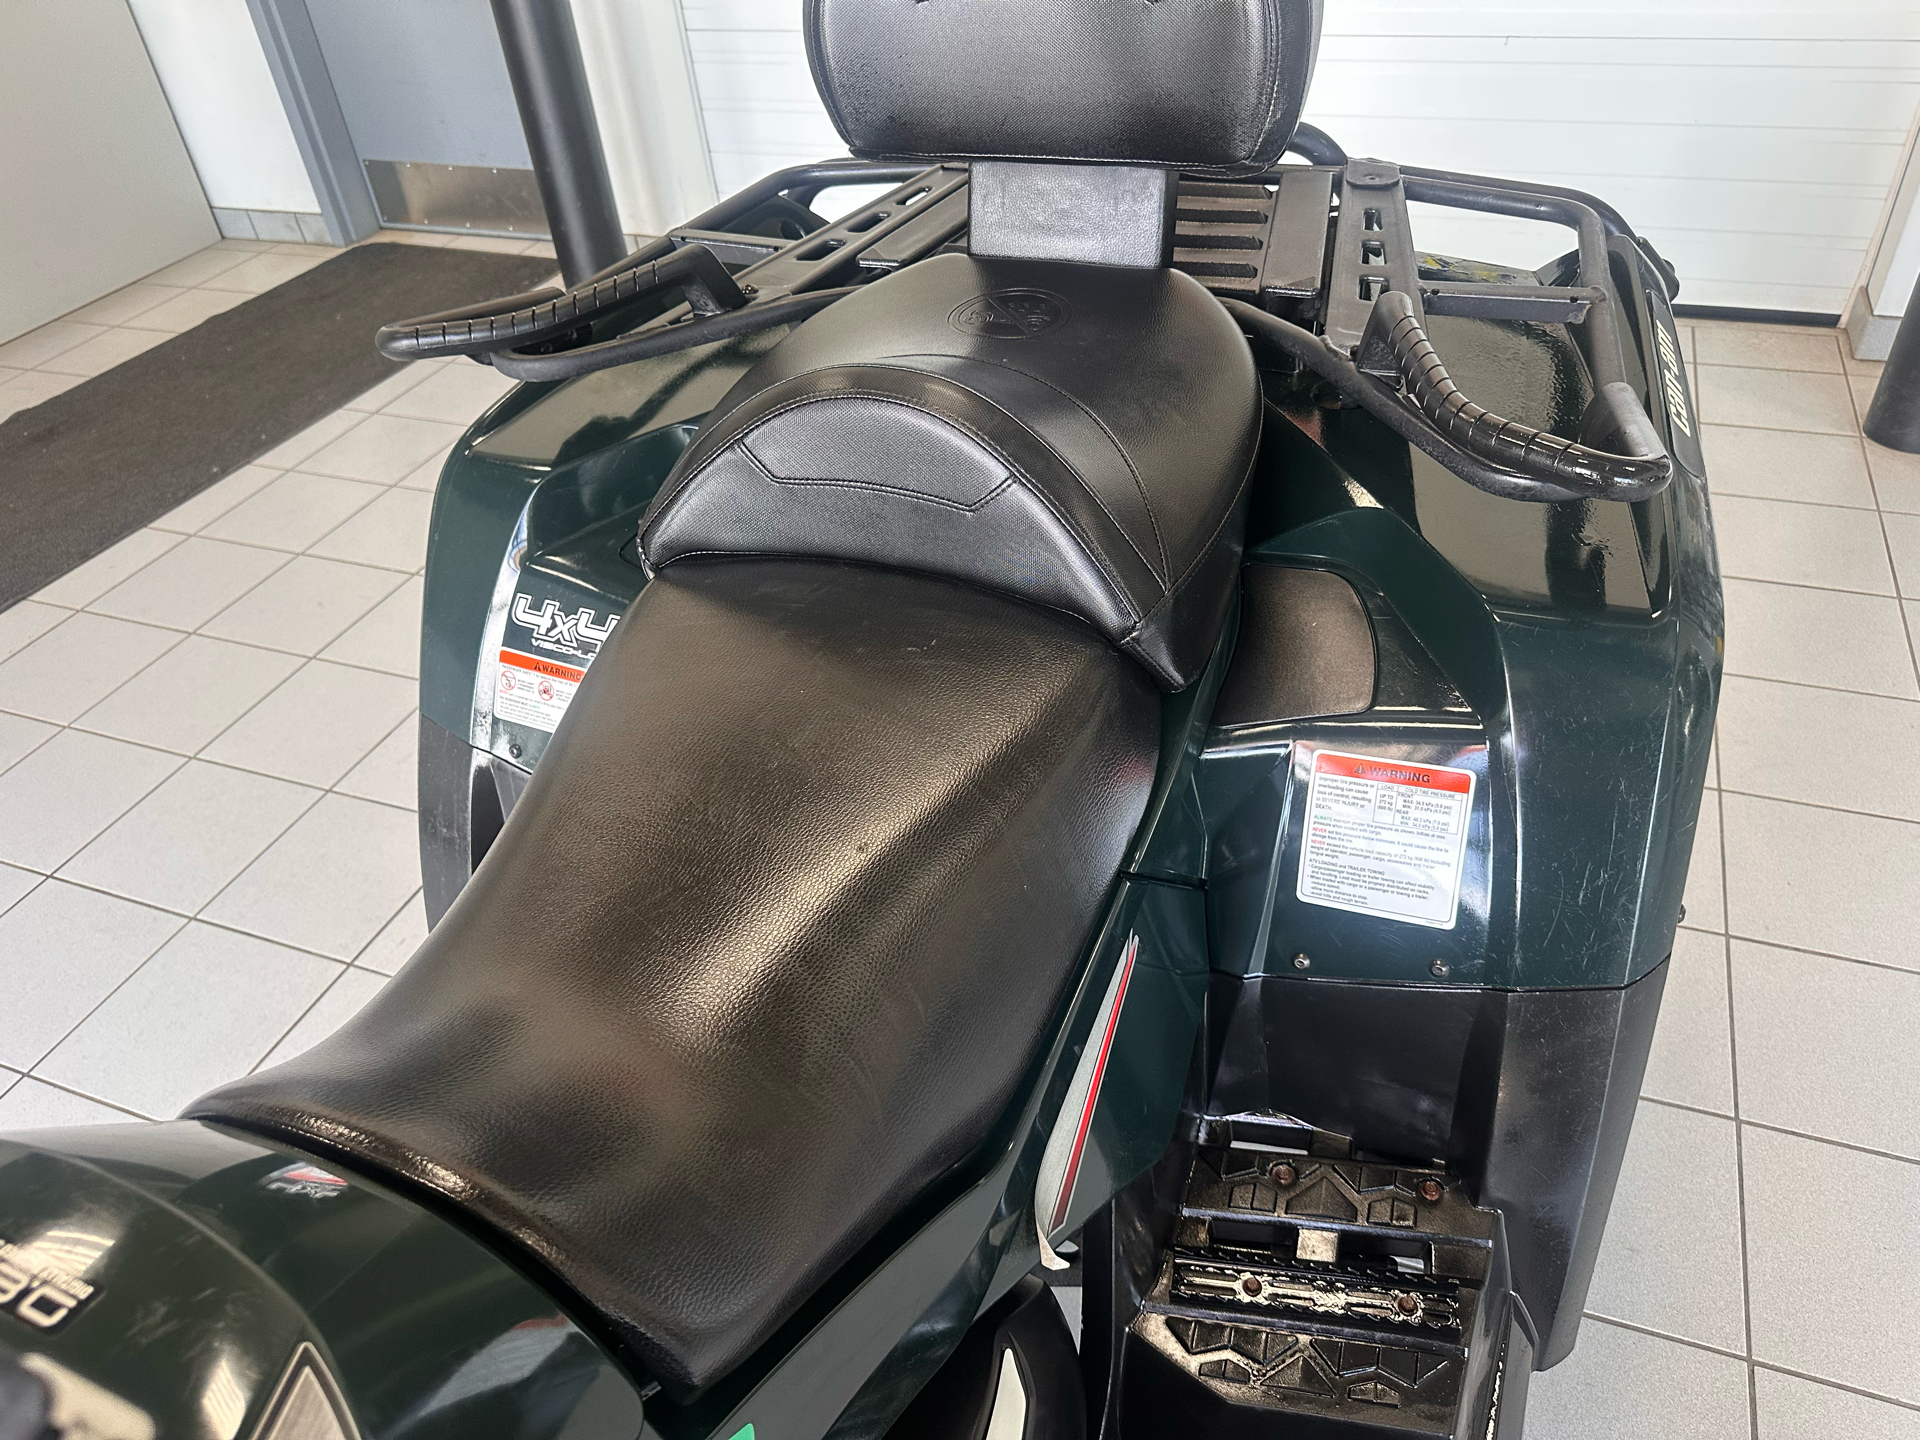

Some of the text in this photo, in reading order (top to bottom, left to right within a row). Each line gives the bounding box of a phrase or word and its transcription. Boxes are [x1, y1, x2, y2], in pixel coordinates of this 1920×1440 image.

[511, 593, 620, 652] 4x4
[543, 664, 582, 681] WARNING
[1369, 766, 1431, 784] WARNING
